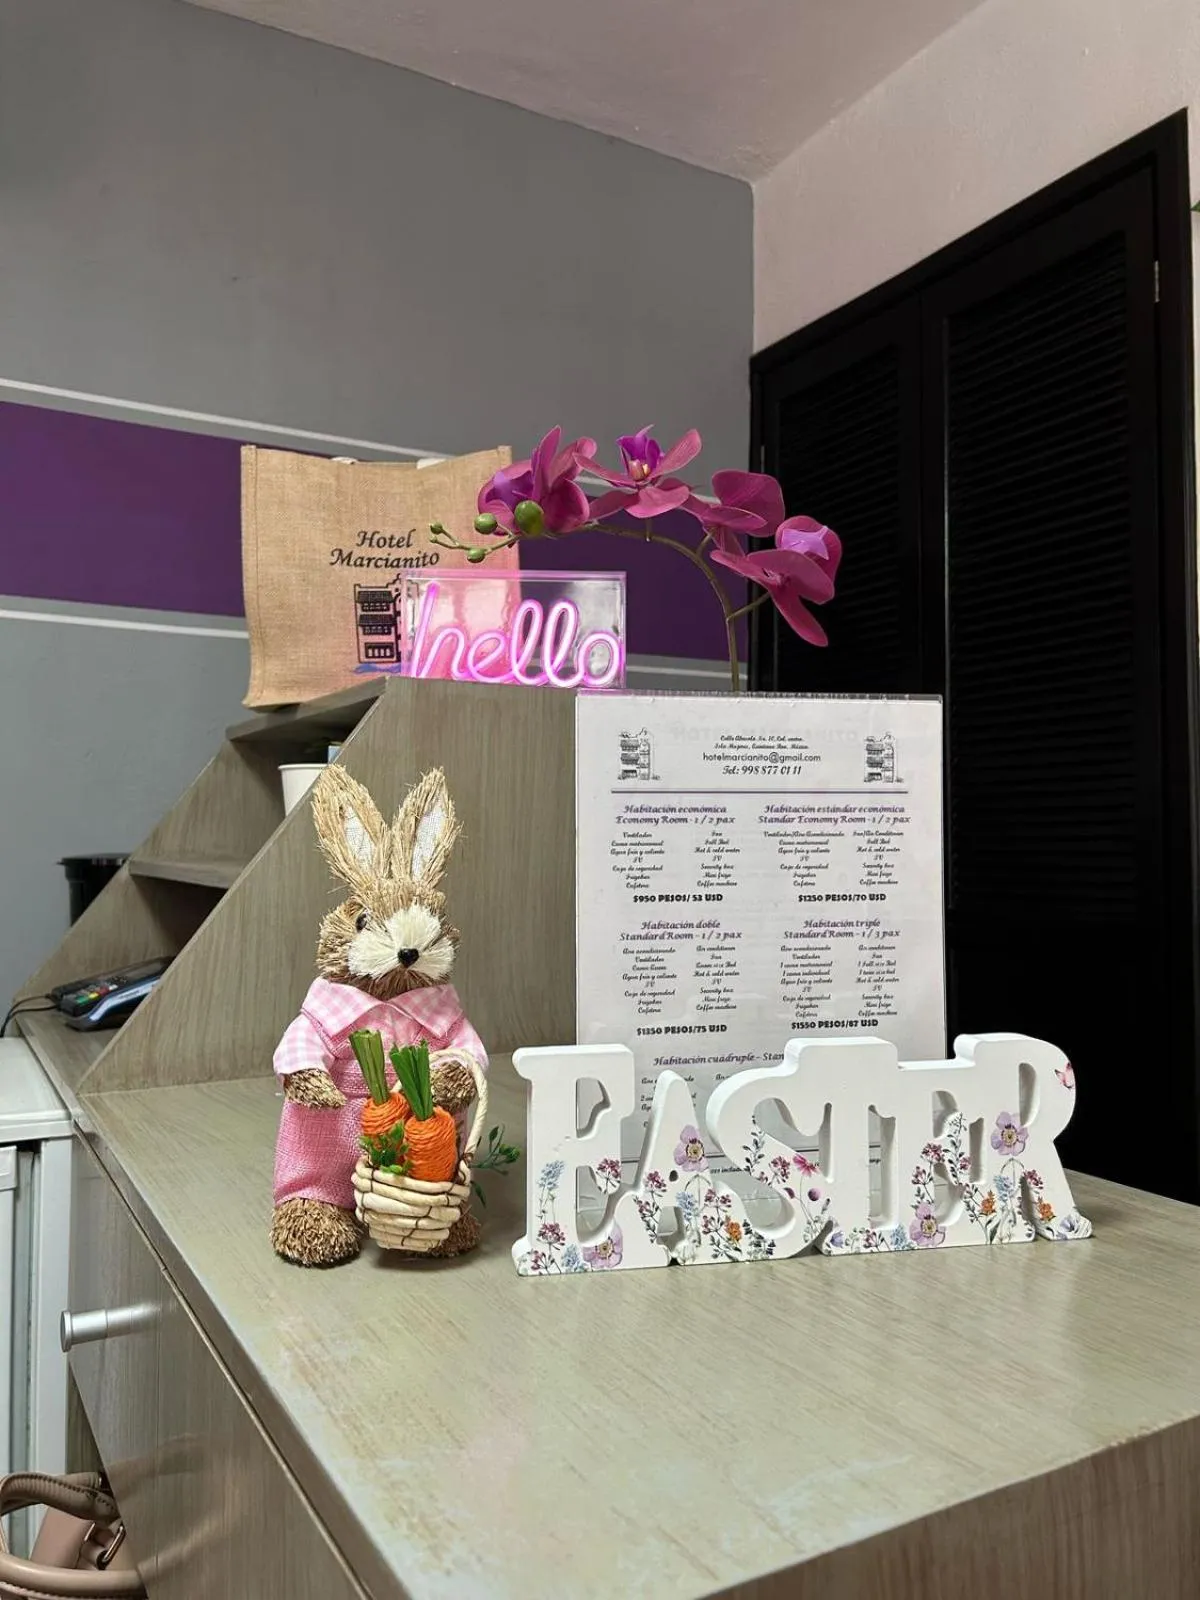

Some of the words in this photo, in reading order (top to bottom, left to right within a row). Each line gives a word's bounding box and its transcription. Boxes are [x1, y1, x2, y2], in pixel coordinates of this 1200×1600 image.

[356, 529, 416, 548] Hotel
[329, 549, 439, 568] Marcianito
[409, 580, 622, 688] hello
[702, 752, 820, 764] hotelmarcianito@gmail.com
[722, 766, 740, 775] Tel:
[742, 766, 760, 774] 998
[761, 766, 778, 774] 877
[624, 804, 676, 814] Habitación
[764, 804, 816, 814] Habitación
[616, 816, 660, 826] Economy
[661, 816, 688, 824] Room
[716, 816, 736, 826] pax
[798, 815, 839, 826] Economy
[840, 816, 866, 824] Room
[892, 816, 911, 825] pax
[658, 894, 690, 902] PESOS/
[705, 894, 723, 902] USD
[869, 894, 886, 902] USD
[640, 920, 694, 930] Habitación
[696, 920, 720, 929] doble
[803, 919, 854, 929] Habitación
[855, 918, 880, 930] triple
[620, 932, 666, 941] Standard
[666, 932, 694, 940] Room
[722, 932, 742, 942] pax
[784, 930, 828, 940] Standard
[882, 930, 901, 940] pax
[708, 1024, 728, 1032] USD
[860, 1019, 878, 1027] USD
[653, 1056, 706, 1066] Habitación
[762, 1052, 785, 1061] Stan
[512, 1033, 1092, 1277] EASTER
